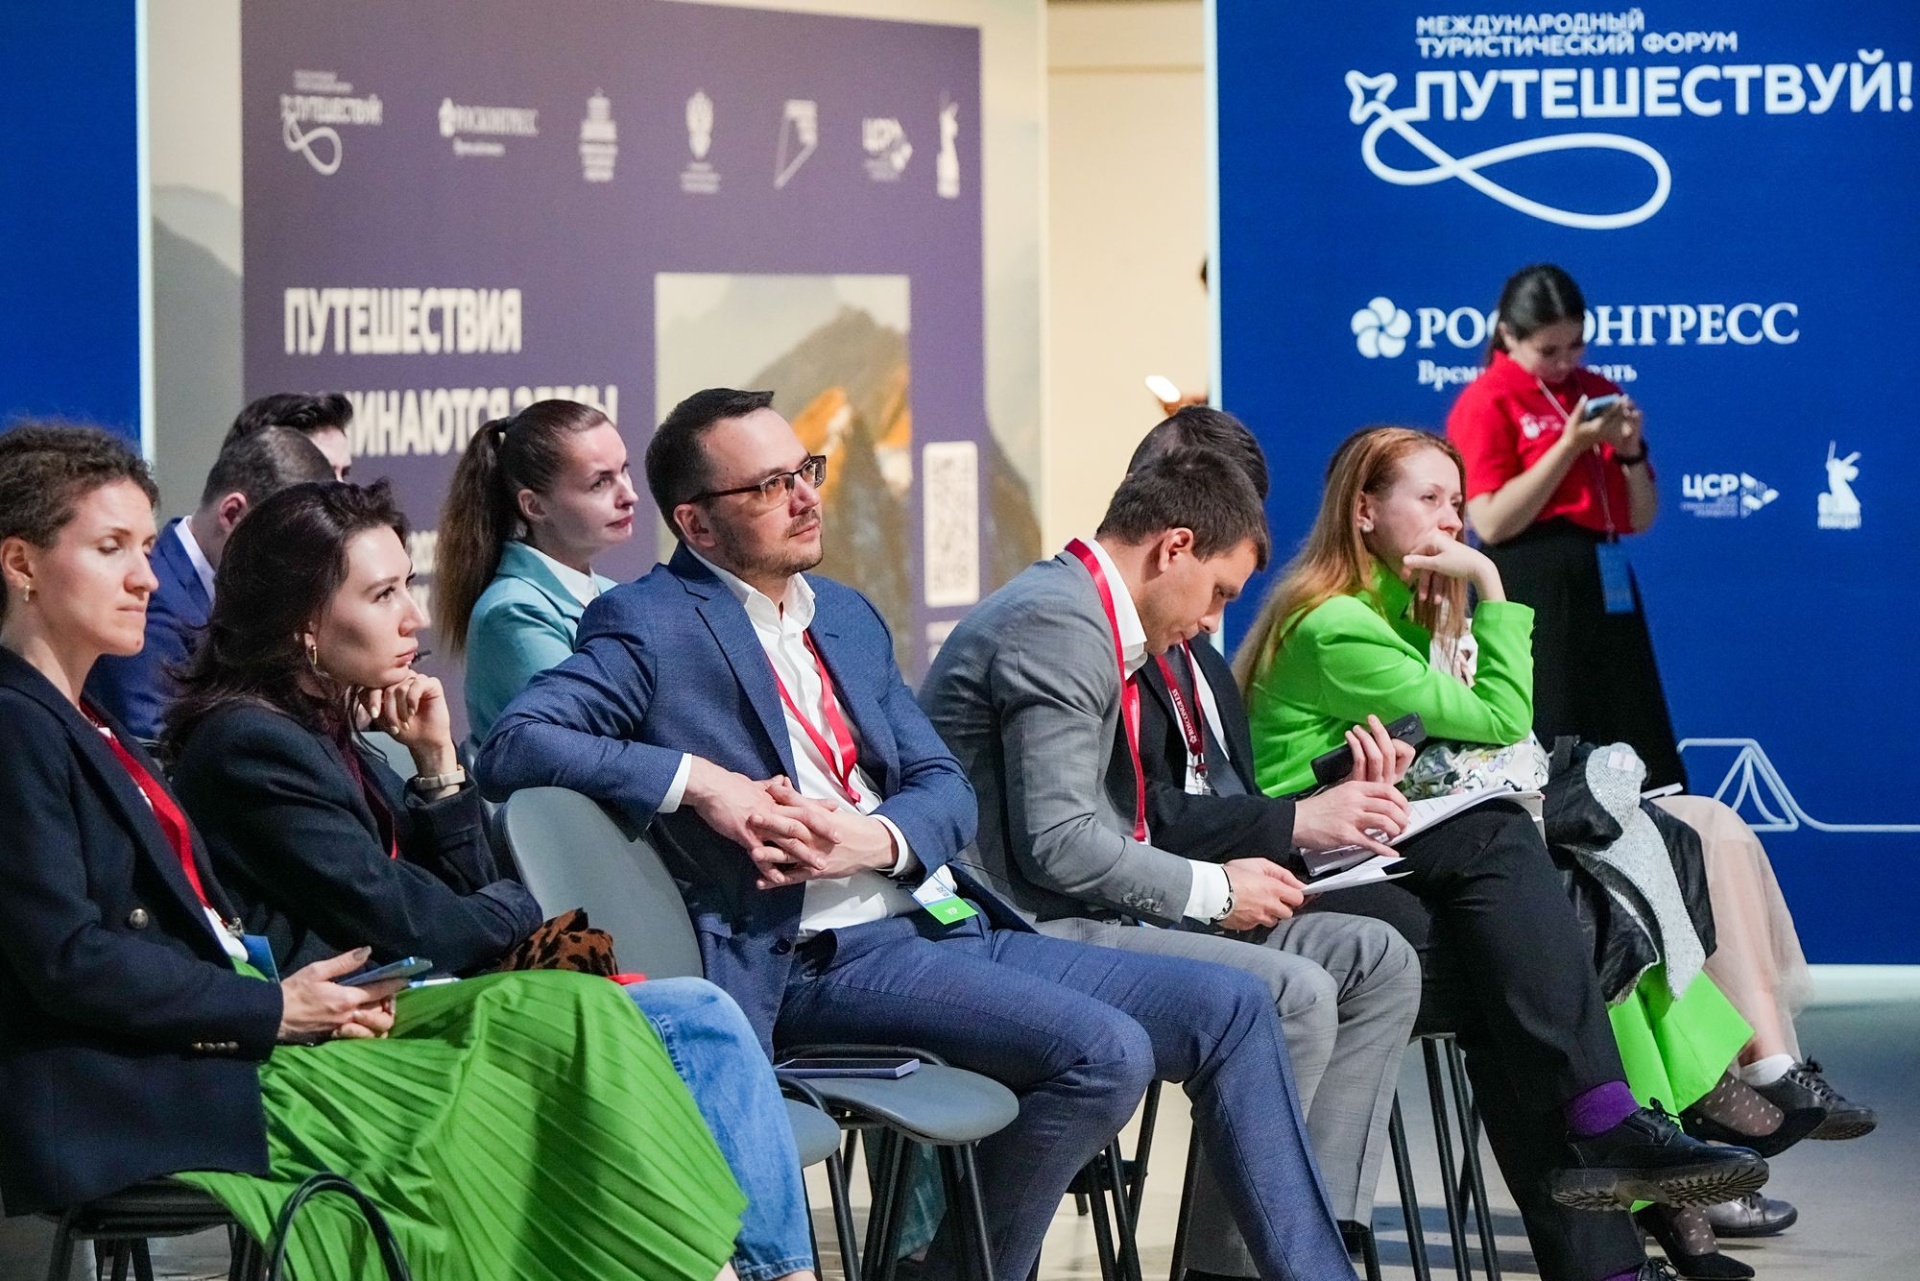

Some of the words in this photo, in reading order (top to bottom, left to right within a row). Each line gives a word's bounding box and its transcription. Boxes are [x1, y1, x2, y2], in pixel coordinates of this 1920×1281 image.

[1416, 8, 1645, 36] МЕЖДУНАРОДНЫЙ
[1415, 31, 1635, 58] ТУРИСТИЧЕСКИЙ
[1641, 32, 1738, 54] ФОРУМ
[1416, 49, 1914, 120] ПУТЕШЕСТВУЙ!
[285, 287, 522, 354] ПУТЕШЕСТВИЯ
[1416, 302, 1799, 347] РОНГРЕСС
[1418, 359, 1485, 391] Врем
[346, 387, 509, 457] ИНАЮТСЯ
[1682, 473, 1739, 500] ЦСР
